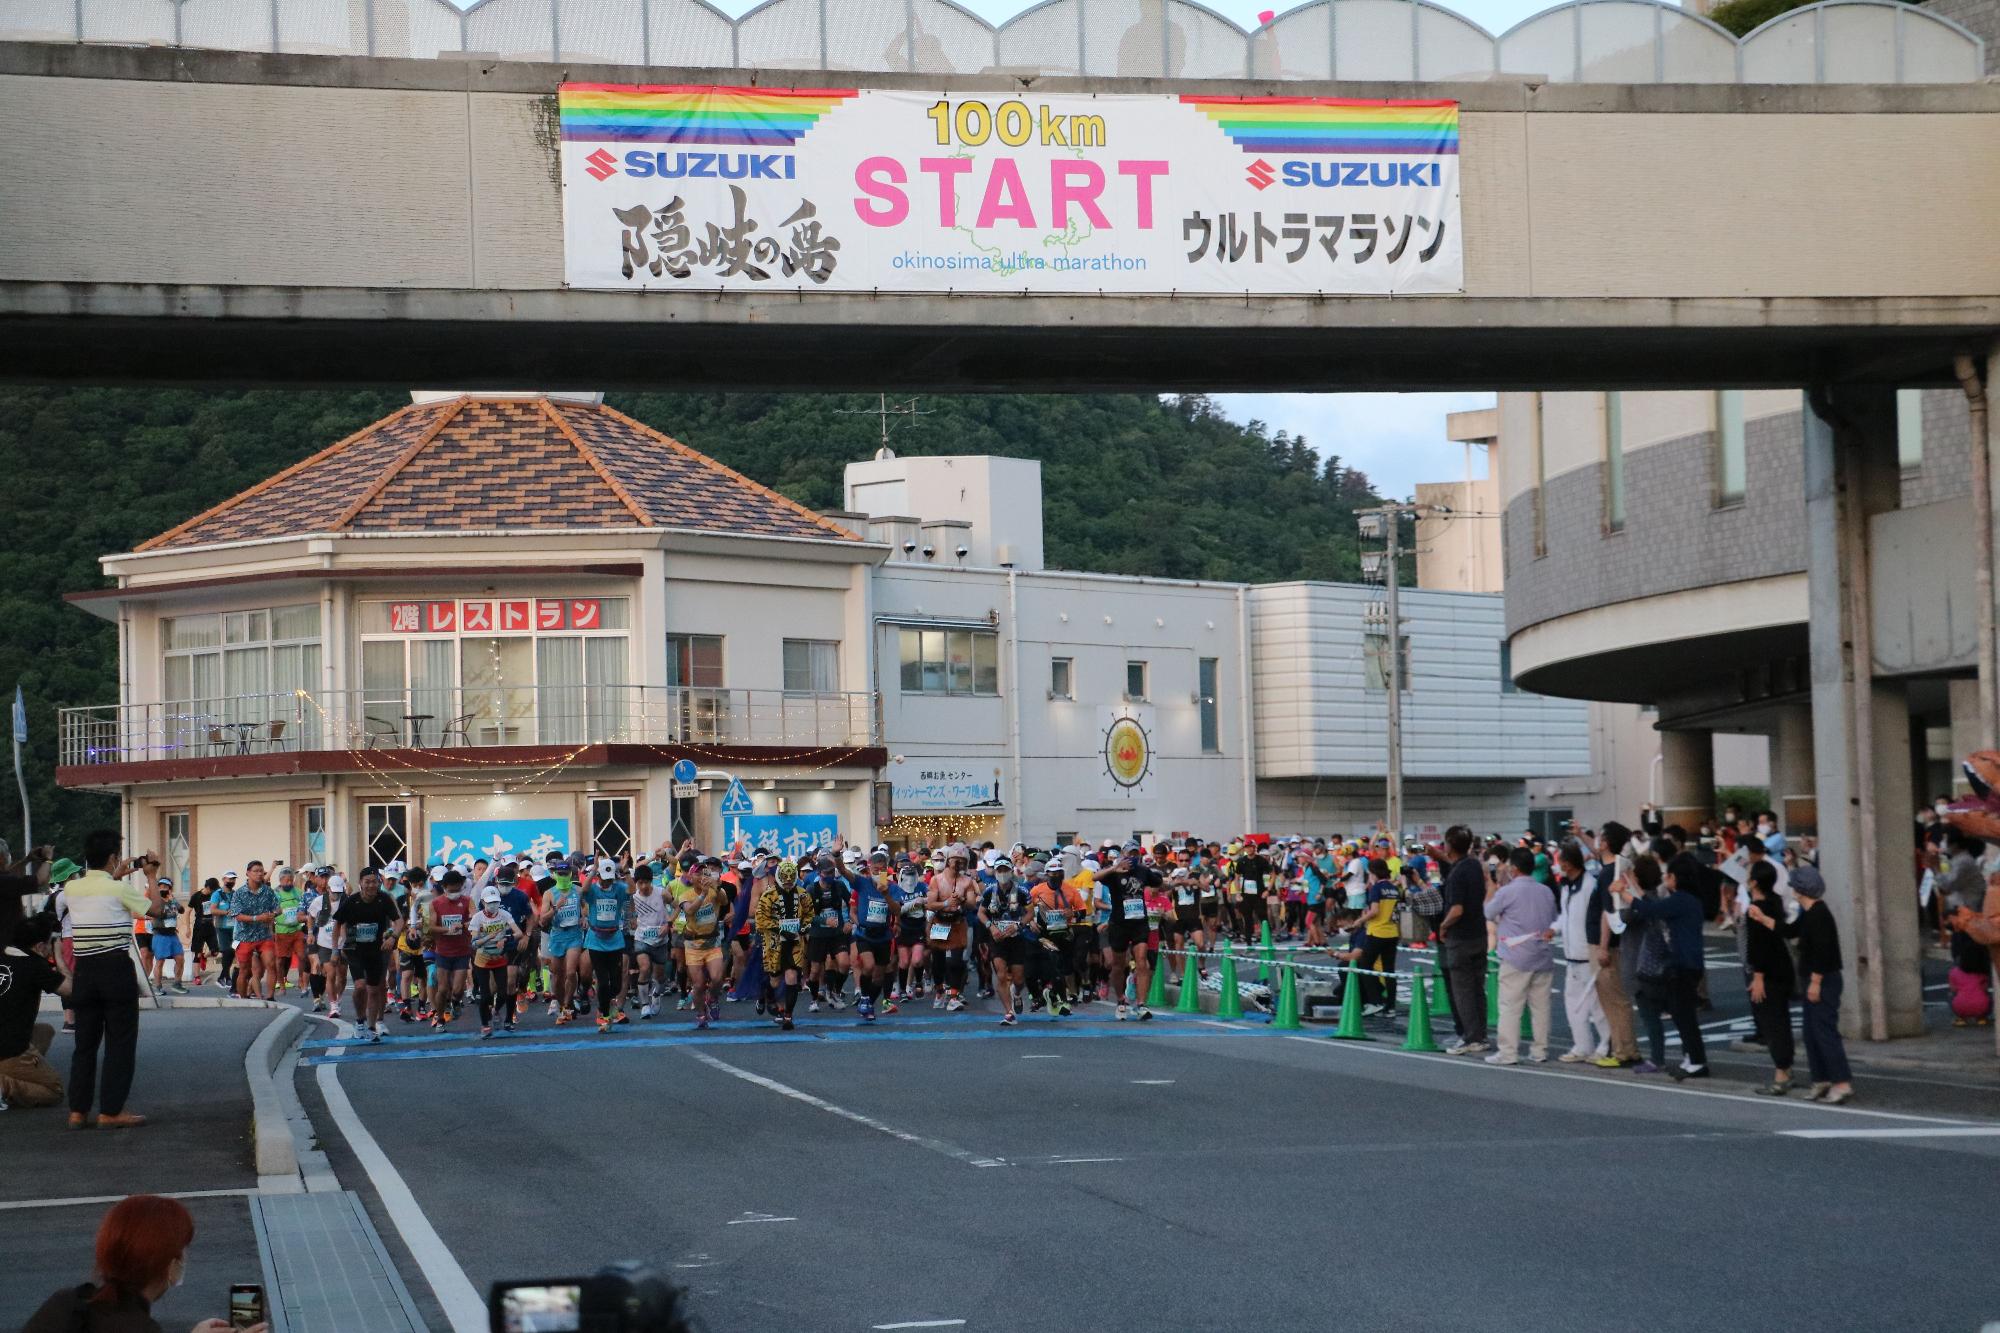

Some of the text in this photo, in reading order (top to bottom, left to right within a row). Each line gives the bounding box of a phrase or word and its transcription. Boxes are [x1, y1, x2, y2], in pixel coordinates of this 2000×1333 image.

[926, 100, 1107, 147] 100km
[625, 150, 796, 180] SUZUKI
[1281, 160, 1441, 188] SUZUKI
[854, 156, 1170, 230] START
[1182, 210, 1446, 264] ウルトラマラソン
[892, 251, 1147, 270] okinosima ultra marathon
